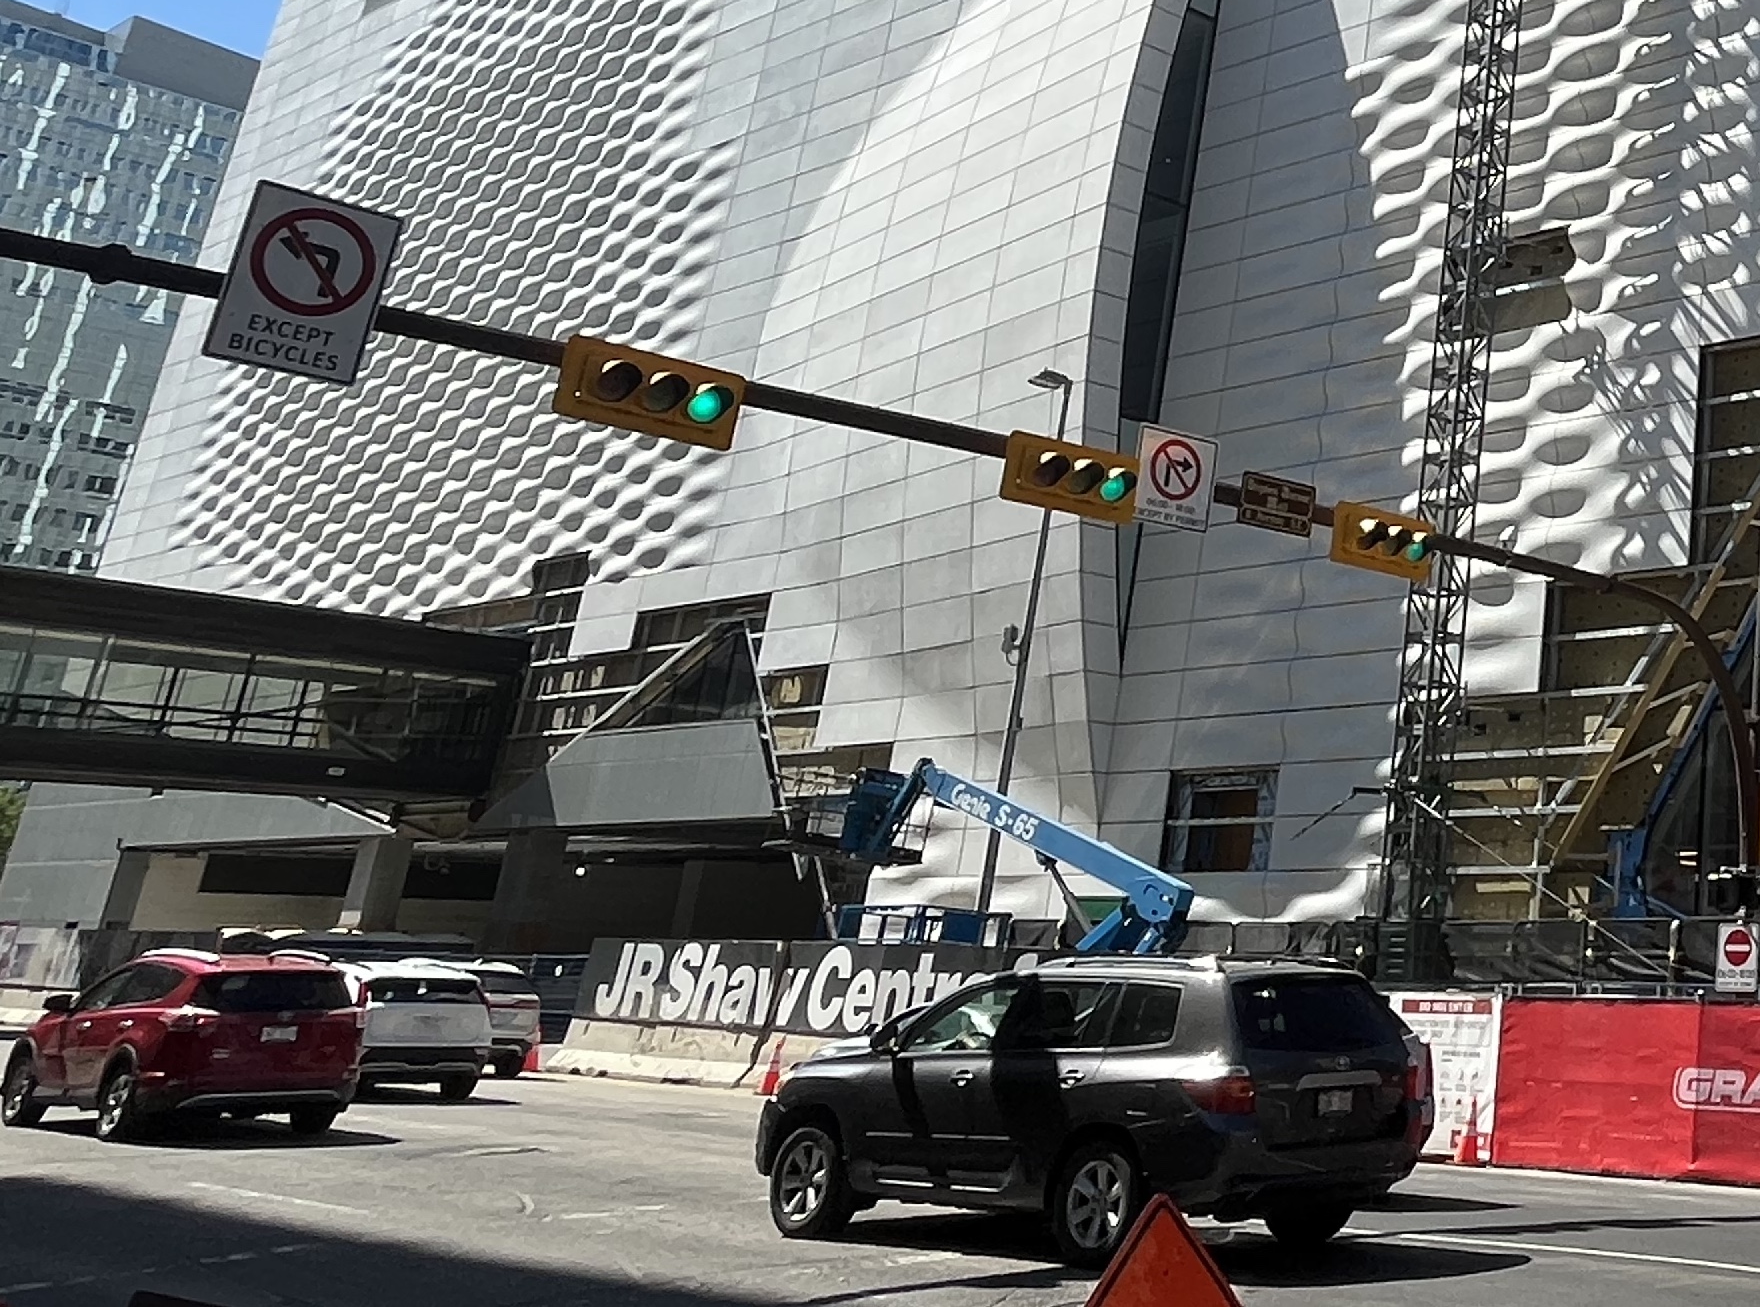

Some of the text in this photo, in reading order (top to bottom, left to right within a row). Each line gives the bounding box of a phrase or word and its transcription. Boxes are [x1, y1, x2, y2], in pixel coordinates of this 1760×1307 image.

[247, 314, 335, 347] EXCEPT
[227, 333, 339, 371] BICYCLES
[951, 783, 991, 820] Genie
[595, 941, 994, 1033] JR Shaw Centr
